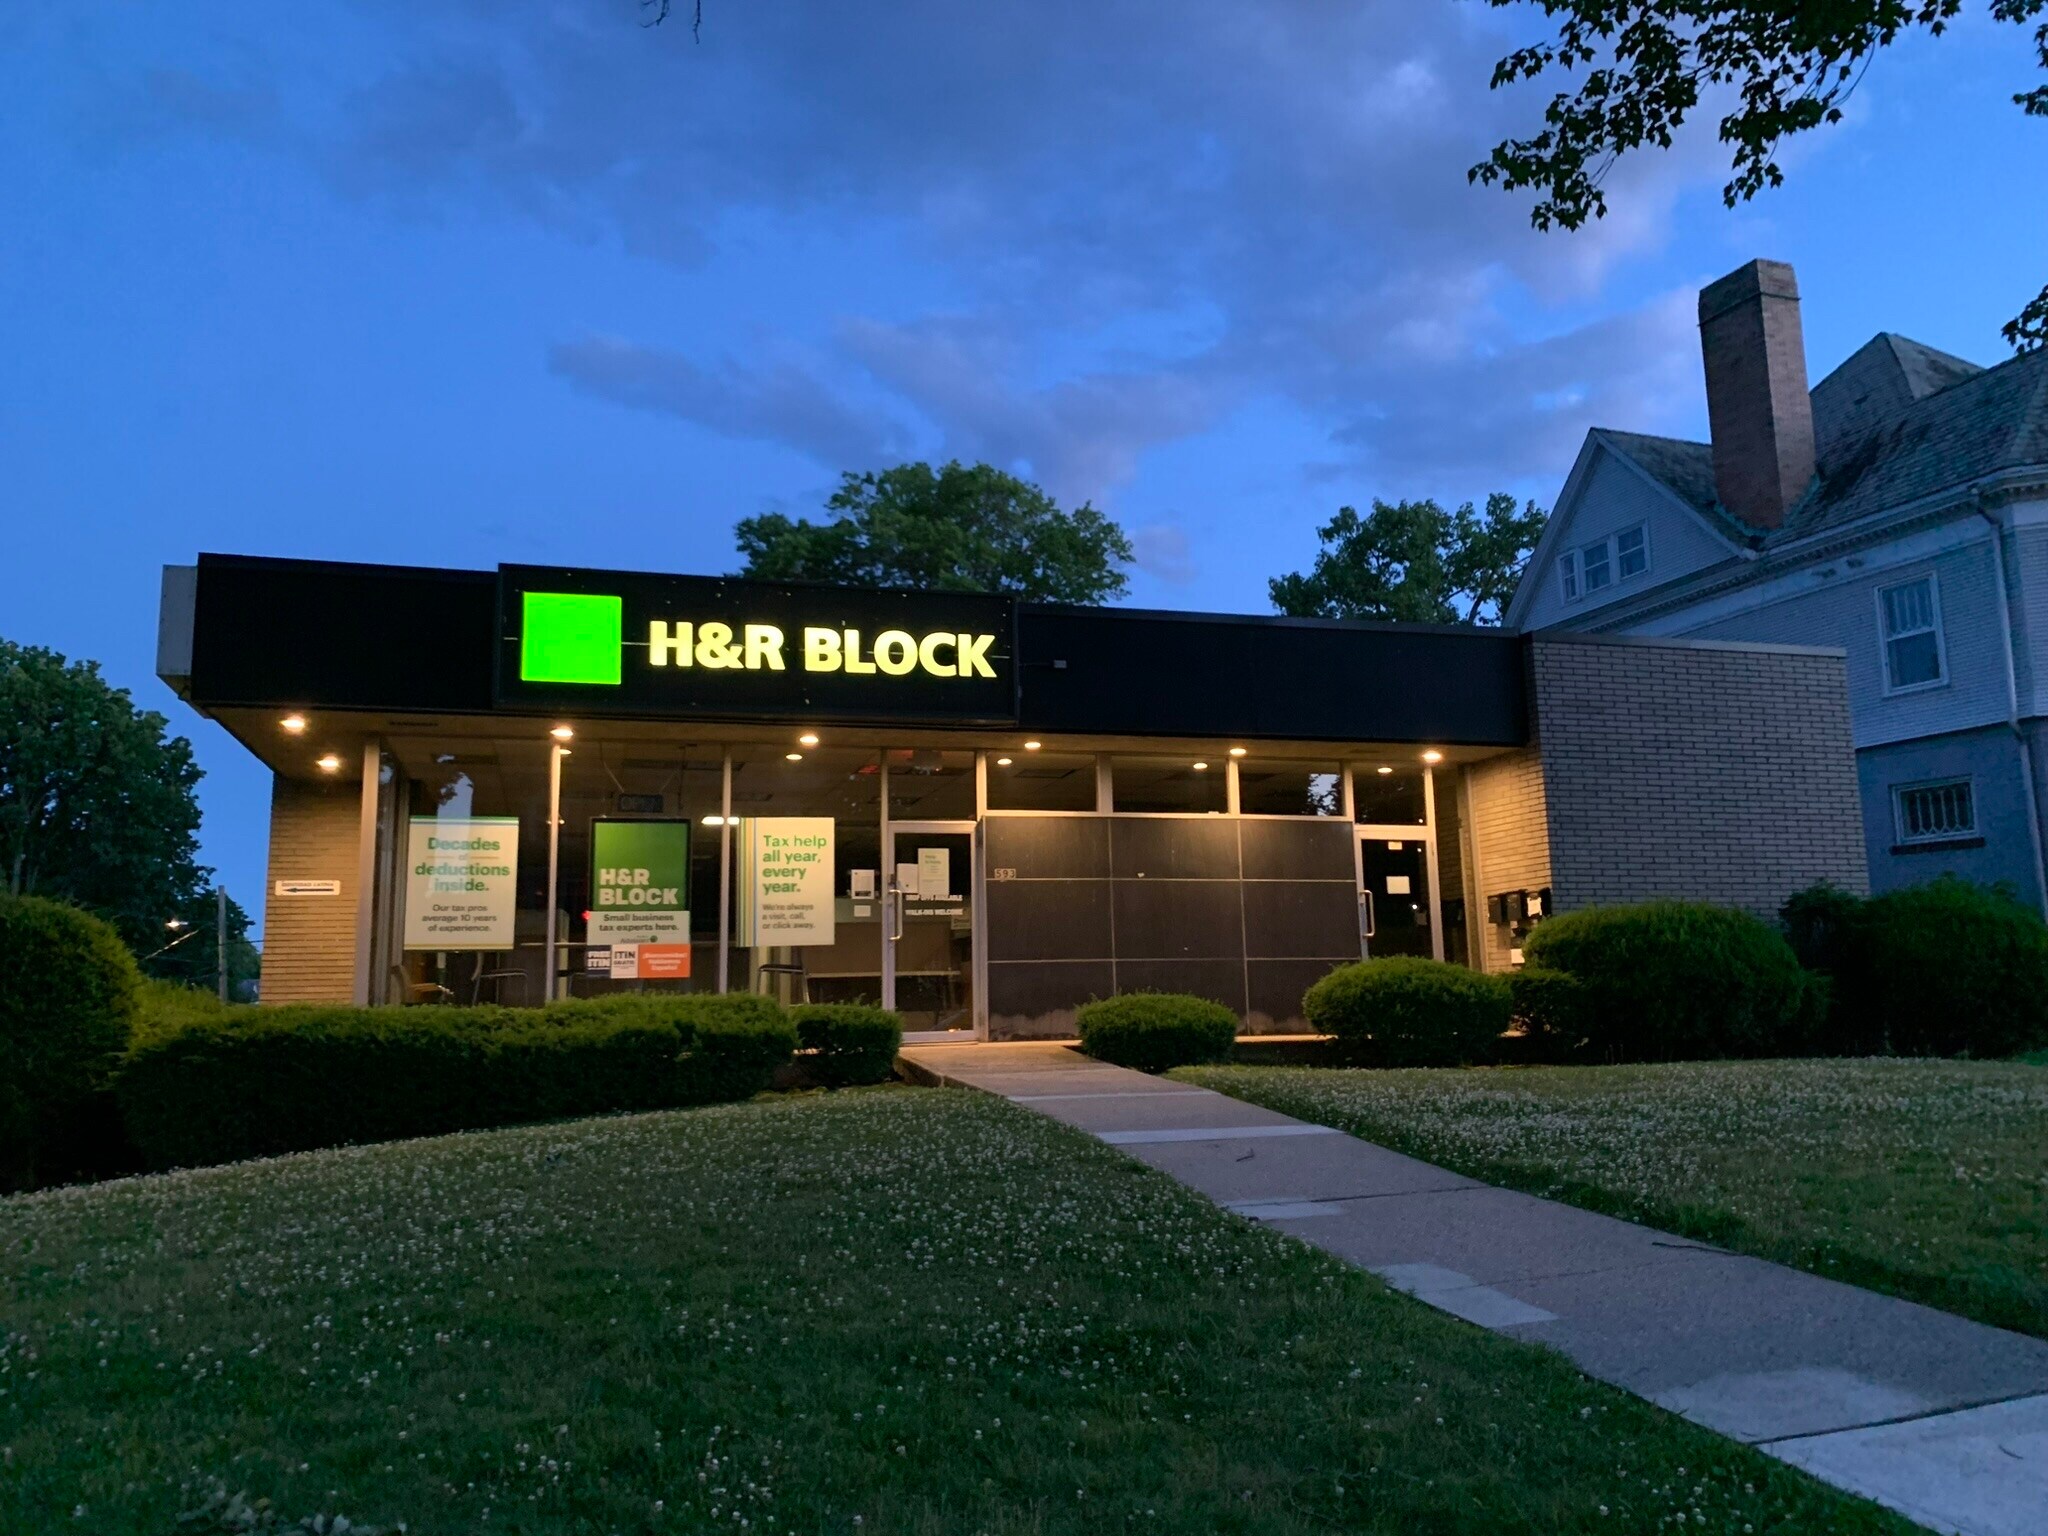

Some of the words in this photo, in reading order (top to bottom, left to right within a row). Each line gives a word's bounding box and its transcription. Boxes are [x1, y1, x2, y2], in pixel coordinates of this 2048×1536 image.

[650, 620, 785, 670] H&R
[804, 627, 997, 678] BLOCK
[427, 837, 501, 851] Decades
[763, 835, 789, 847] Tax
[794, 834, 827, 848] help
[762, 850, 780, 862] all
[785, 852, 821, 865] year,
[415, 862, 510, 876] deductions
[762, 867, 806, 880] every
[996, 869, 1015, 878] 593
[599, 868, 650, 886] H&R
[434, 878, 490, 892] inside.
[762, 883, 802, 896] year.
[599, 888, 679, 905] BLOCK
[432, 904, 449, 912] Our
[467, 905, 488, 913] pros
[786, 904, 814, 912] always
[422, 915, 458, 924] average
[473, 915, 497, 923] years
[603, 914, 631, 922] Small
[632, 913, 674, 922] business
[439, 925, 491, 933] experience.
[599, 924, 614, 932] tax
[616, 924, 653, 933] experts
[655, 923, 680, 931] here.
[614, 950, 635, 959] ITIN
